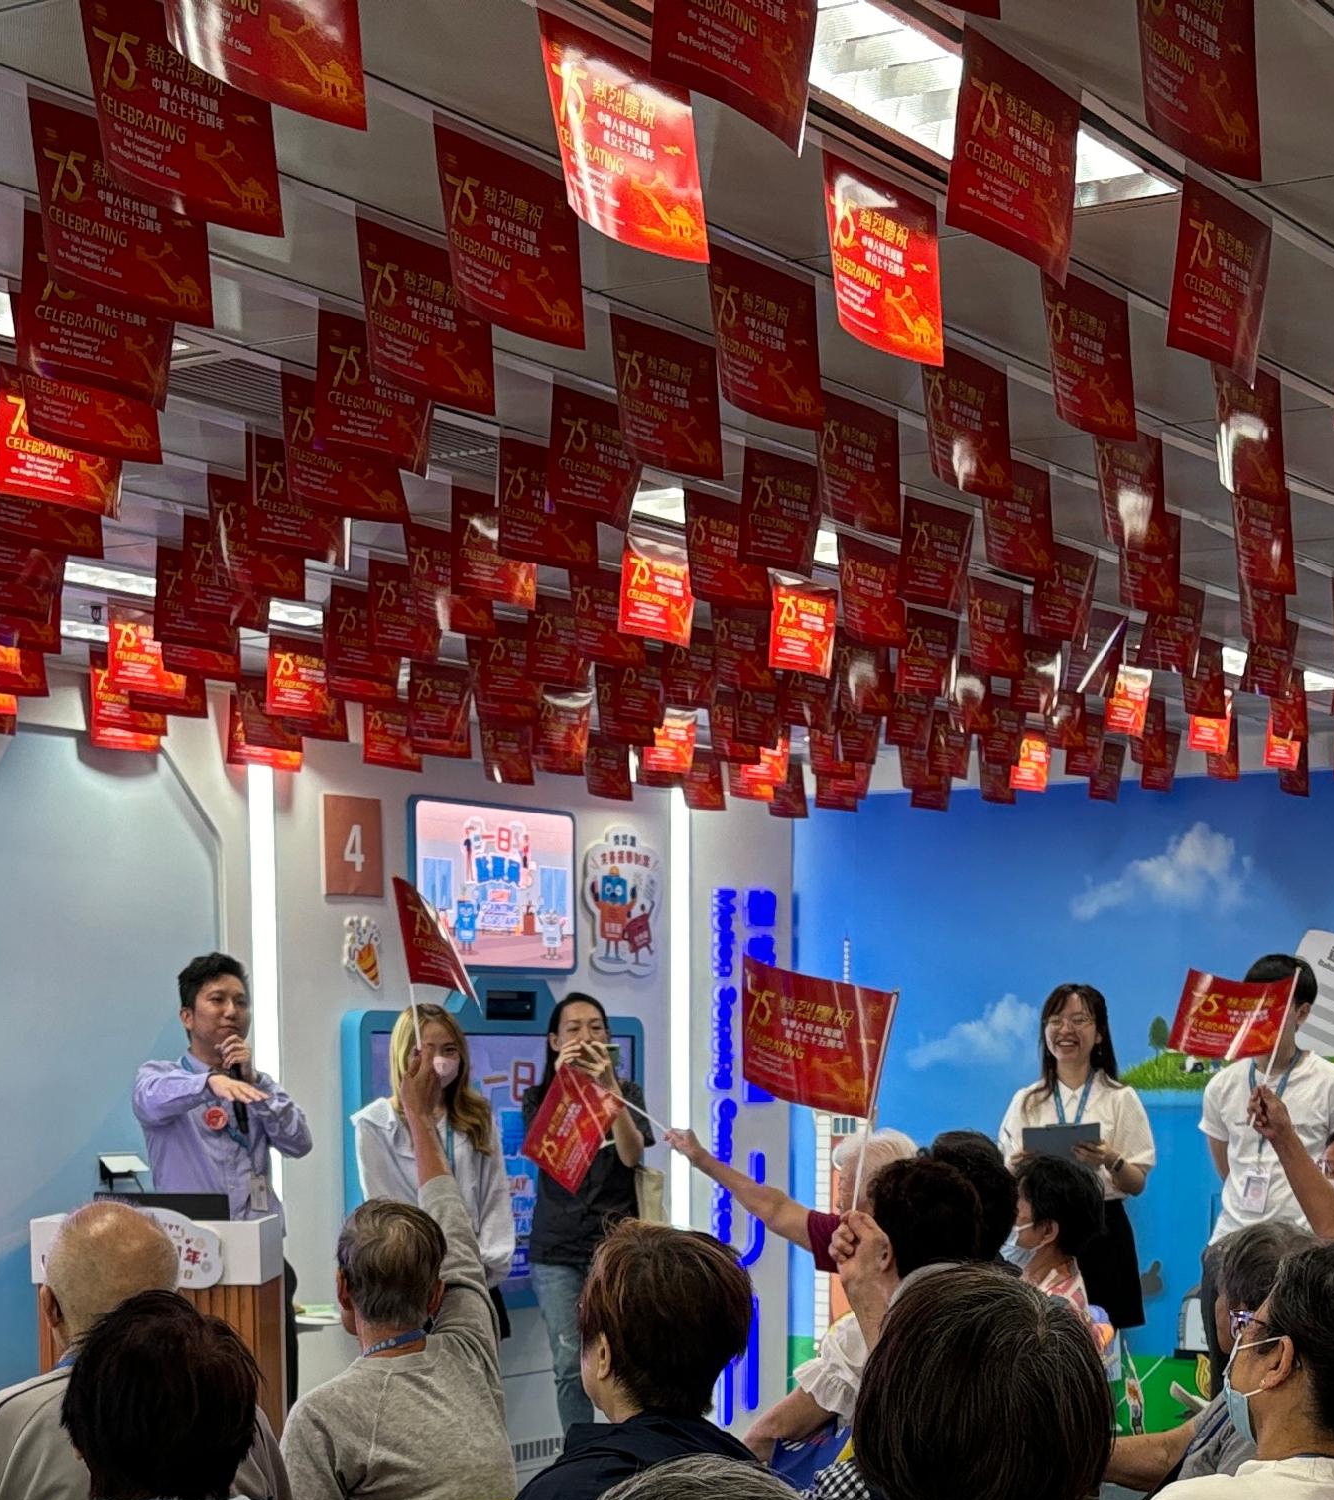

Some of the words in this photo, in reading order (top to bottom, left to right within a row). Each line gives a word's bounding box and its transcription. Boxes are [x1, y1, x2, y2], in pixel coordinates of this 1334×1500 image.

[92, 26, 140, 92] 75
[151, 77, 218, 113] 中華人民共和國
[159, 97, 225, 131] 成立七十五周年
[551, 62, 588, 124] 75
[592, 78, 656, 129] 熱烈慶祝
[971, 78, 1003, 139] 75
[101, 92, 186, 145] CELEBRATING
[1003, 93, 1055, 146] 熱烈慶祝
[43, 147, 87, 203] 75
[964, 140, 1029, 189] CELEBRATING
[97, 190, 158, 219] 中華人民共和國
[445, 173, 480, 227] 75
[483, 185, 544, 229] 熱烈慶祝
[48, 205, 128, 248] CELEBRATING
[486, 214, 537, 242] 中華人民共和國
[491, 231, 541, 258] 成立七十五周年
[858, 207, 910, 250] 熱烈慶祝
[1188, 218, 1215, 270] 75
[450, 228, 511, 271] CELEBRATING
[367, 260, 399, 308] 75
[35, 305, 117, 339] CELEBRATING
[370, 310, 430, 344] CELEBRATING
[5, 436, 74, 462] CELEBRATING
[629, 557, 651, 587] 75
[778, 595, 797, 624] 75
[343, 823, 365, 872] 4
[780, 996, 855, 1029] 熱烈慶祝
